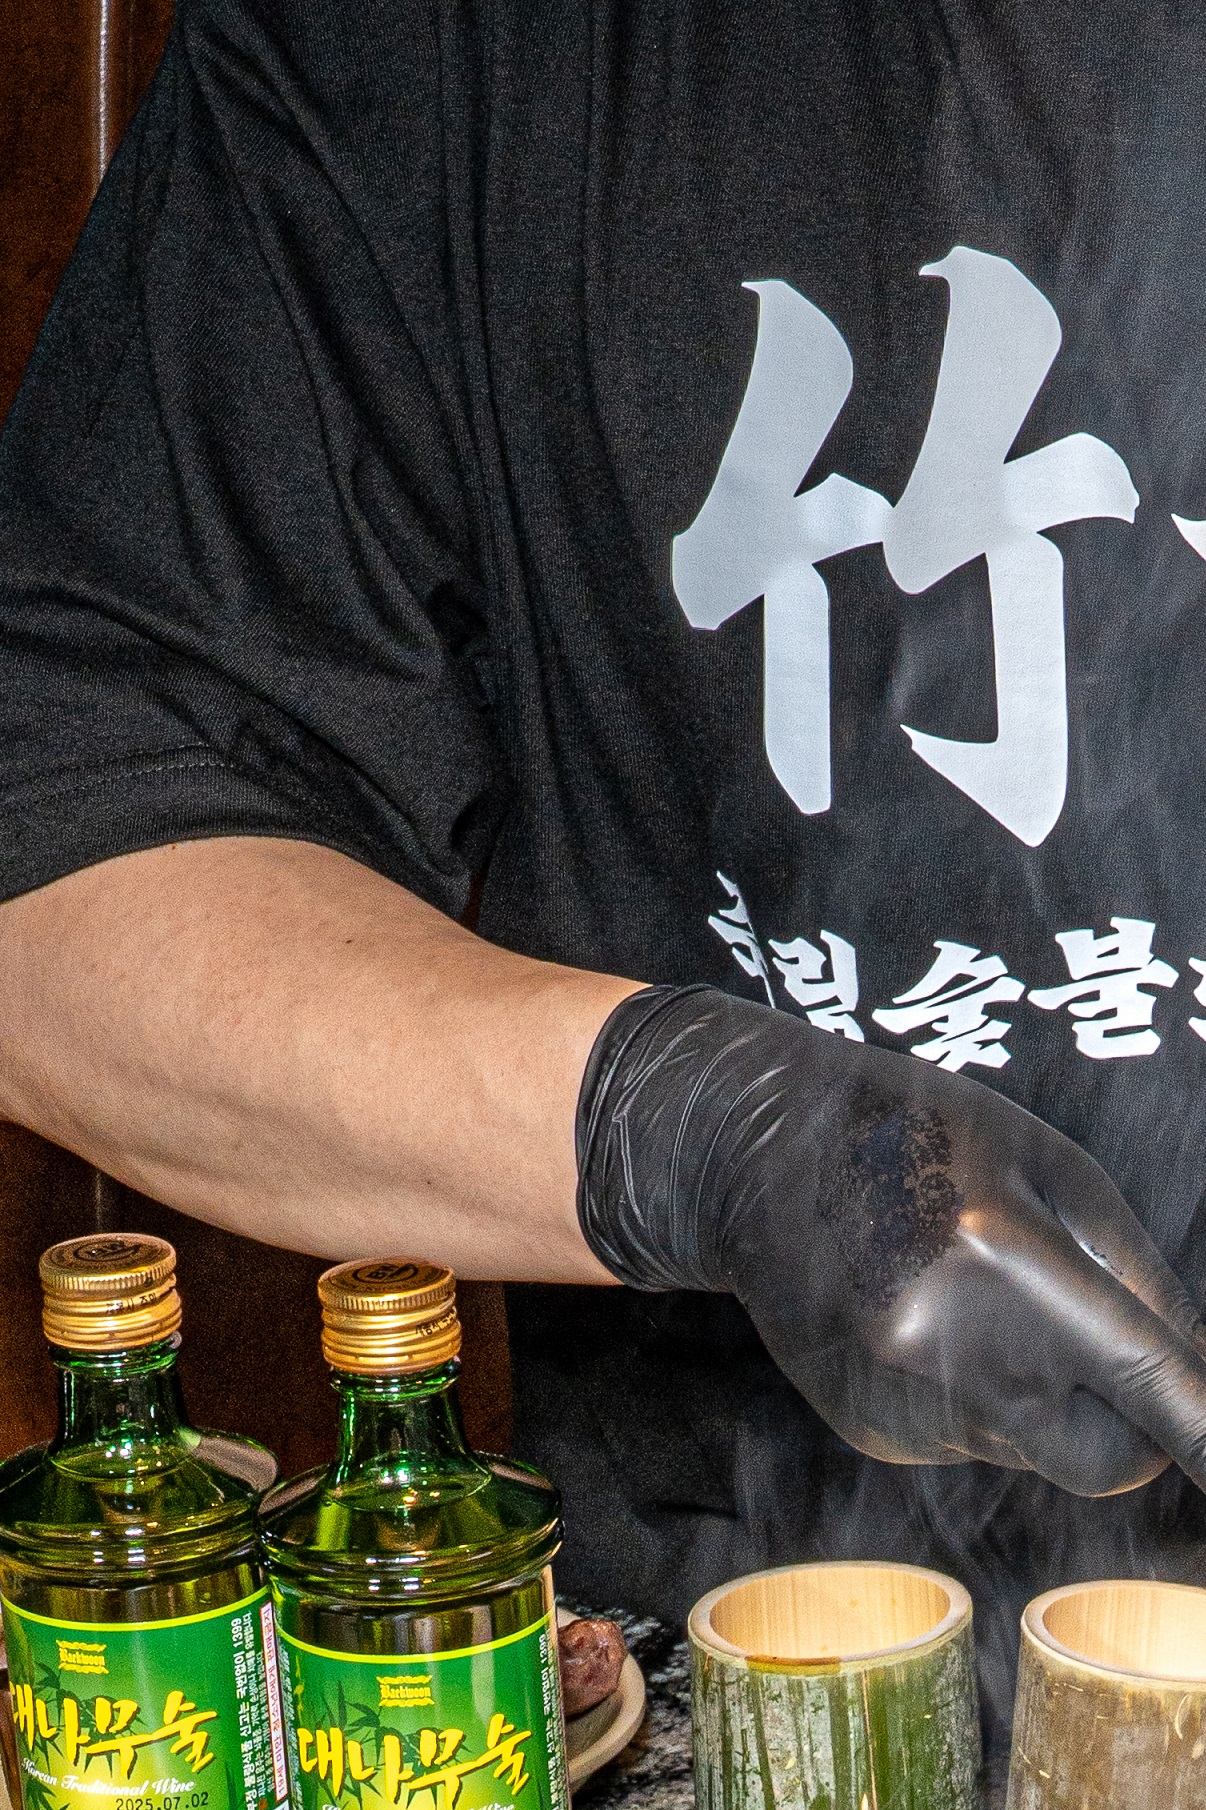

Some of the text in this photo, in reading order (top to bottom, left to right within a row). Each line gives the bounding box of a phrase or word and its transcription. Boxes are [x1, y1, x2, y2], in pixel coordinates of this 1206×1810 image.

[231, 1618, 243, 1648] 1399
[233, 1651, 248, 1699] 국번없이
[238, 1702, 252, 1737] 신고는
[263, 1608, 285, 1793] 19세 미만 청소년에게 판매금지
[22, 1757, 195, 1797] Korean Traditional Wine
